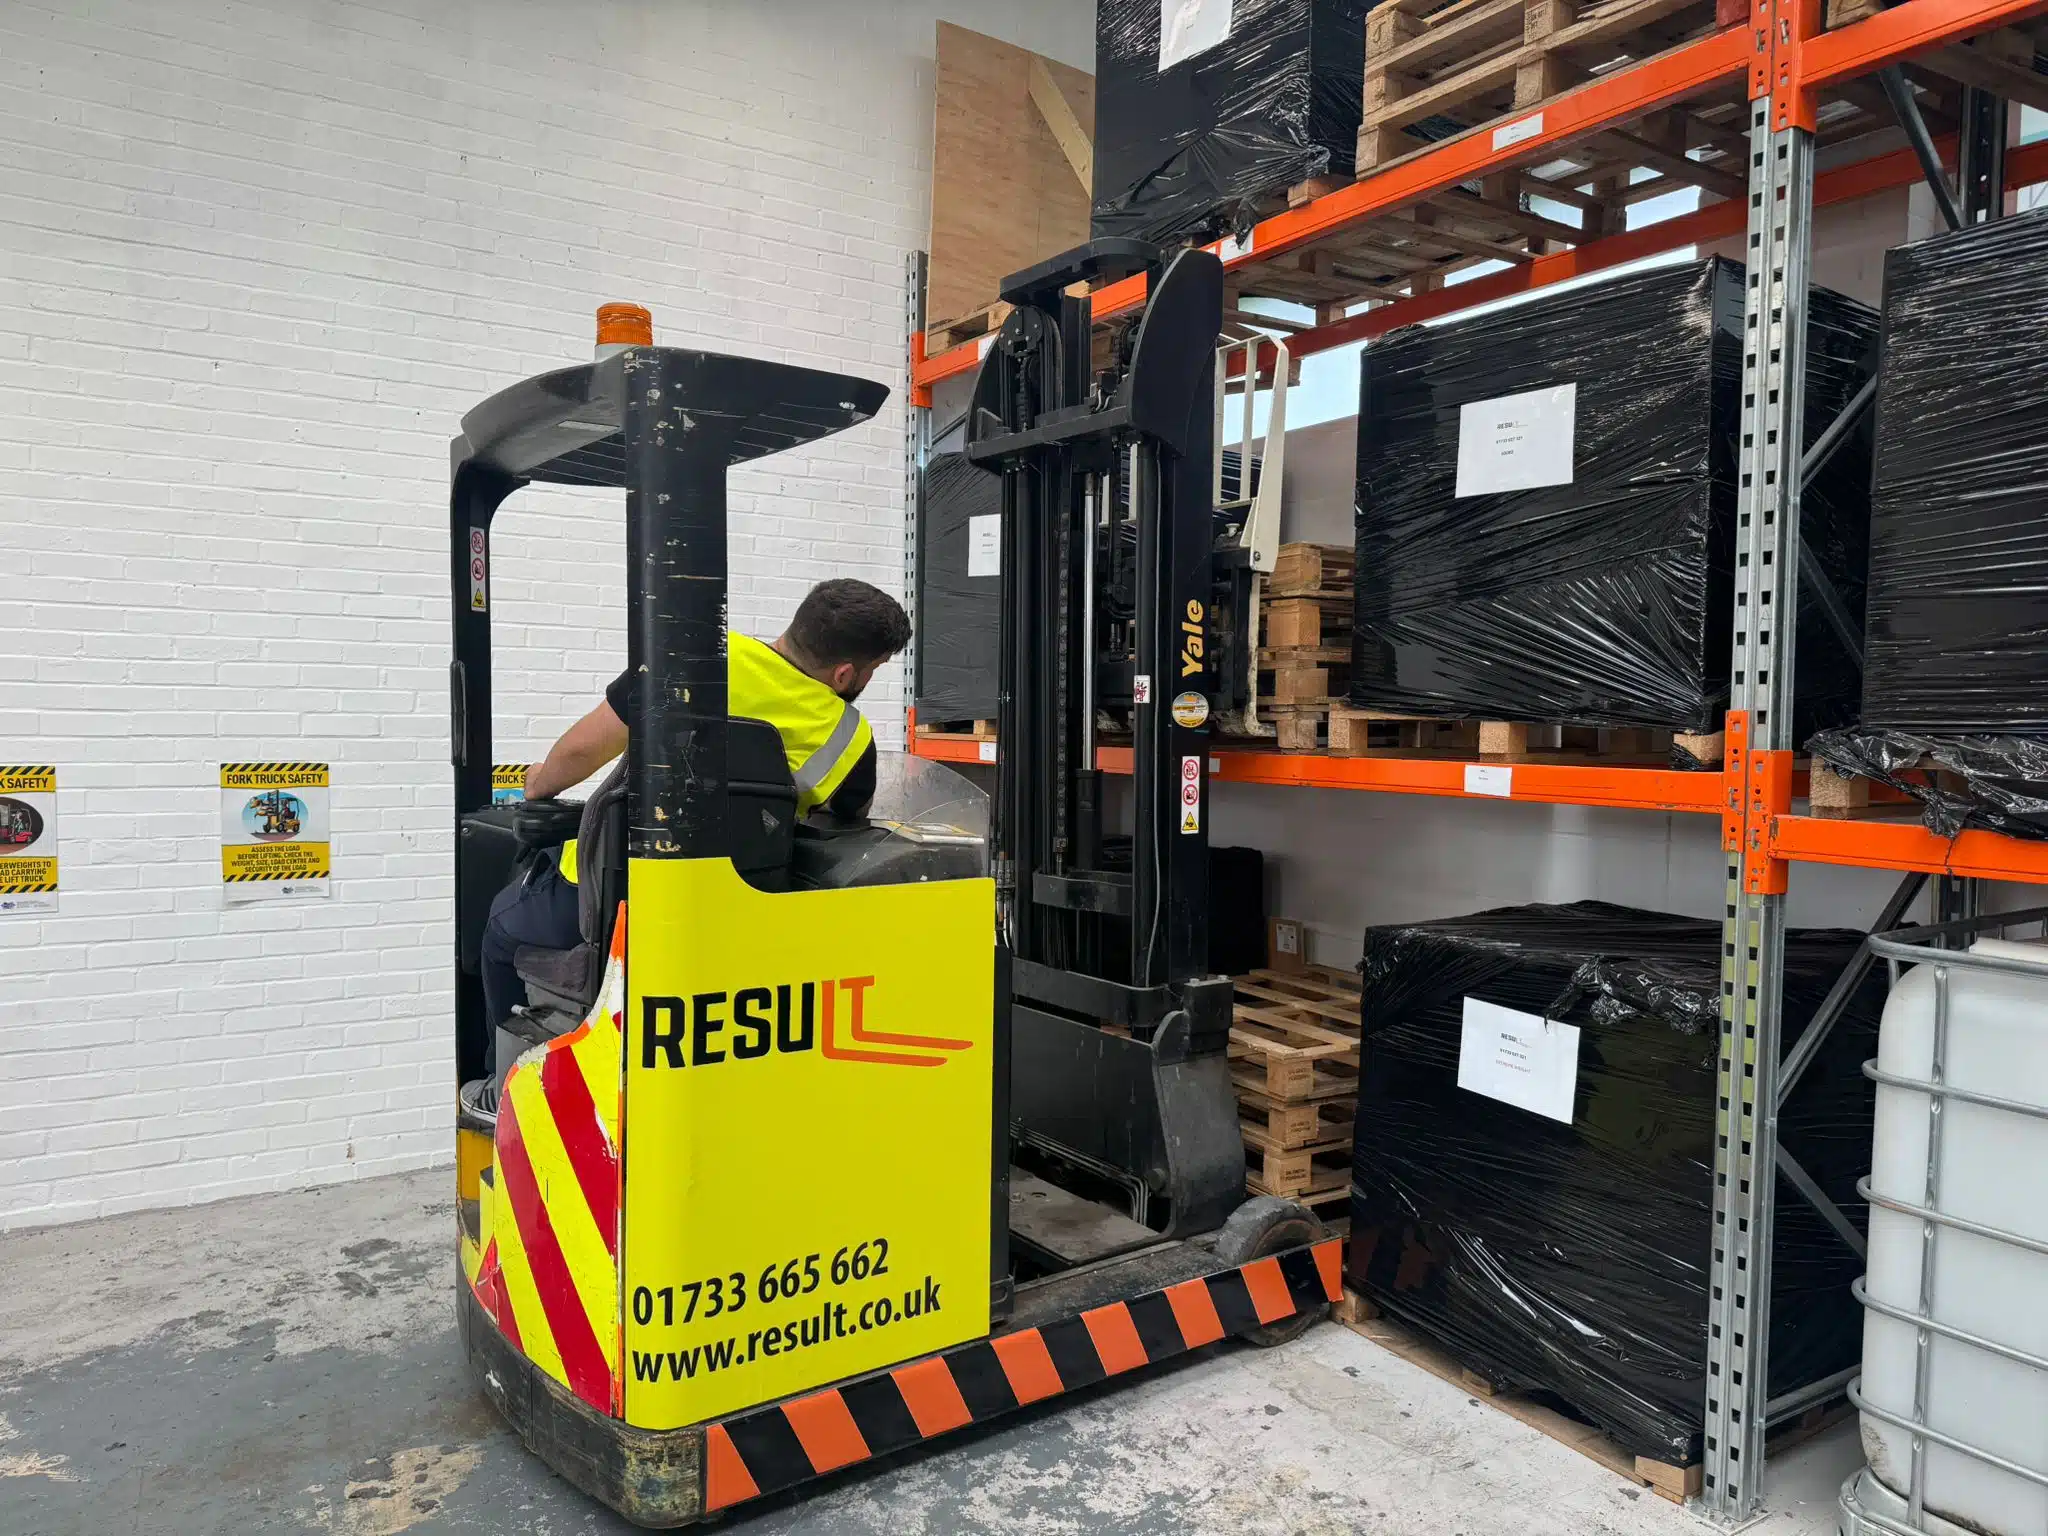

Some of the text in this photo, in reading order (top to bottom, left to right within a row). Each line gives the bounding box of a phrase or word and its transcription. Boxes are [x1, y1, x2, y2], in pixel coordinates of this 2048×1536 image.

[1182, 599, 1204, 677] Yale
[7, 777, 48, 789] SAFETY
[227, 773, 323, 784] FORK TRUCK SAFETY
[492, 774, 519, 784] TRUCK
[42, 860, 51, 868] TO
[11, 868, 47, 876] CARRYING
[4, 875, 18, 883] LIFT
[641, 975, 974, 1069] RESULT
[633, 1238, 889, 1326] 01733 665 662
[632, 1275, 941, 1383] www.result.co.uk
